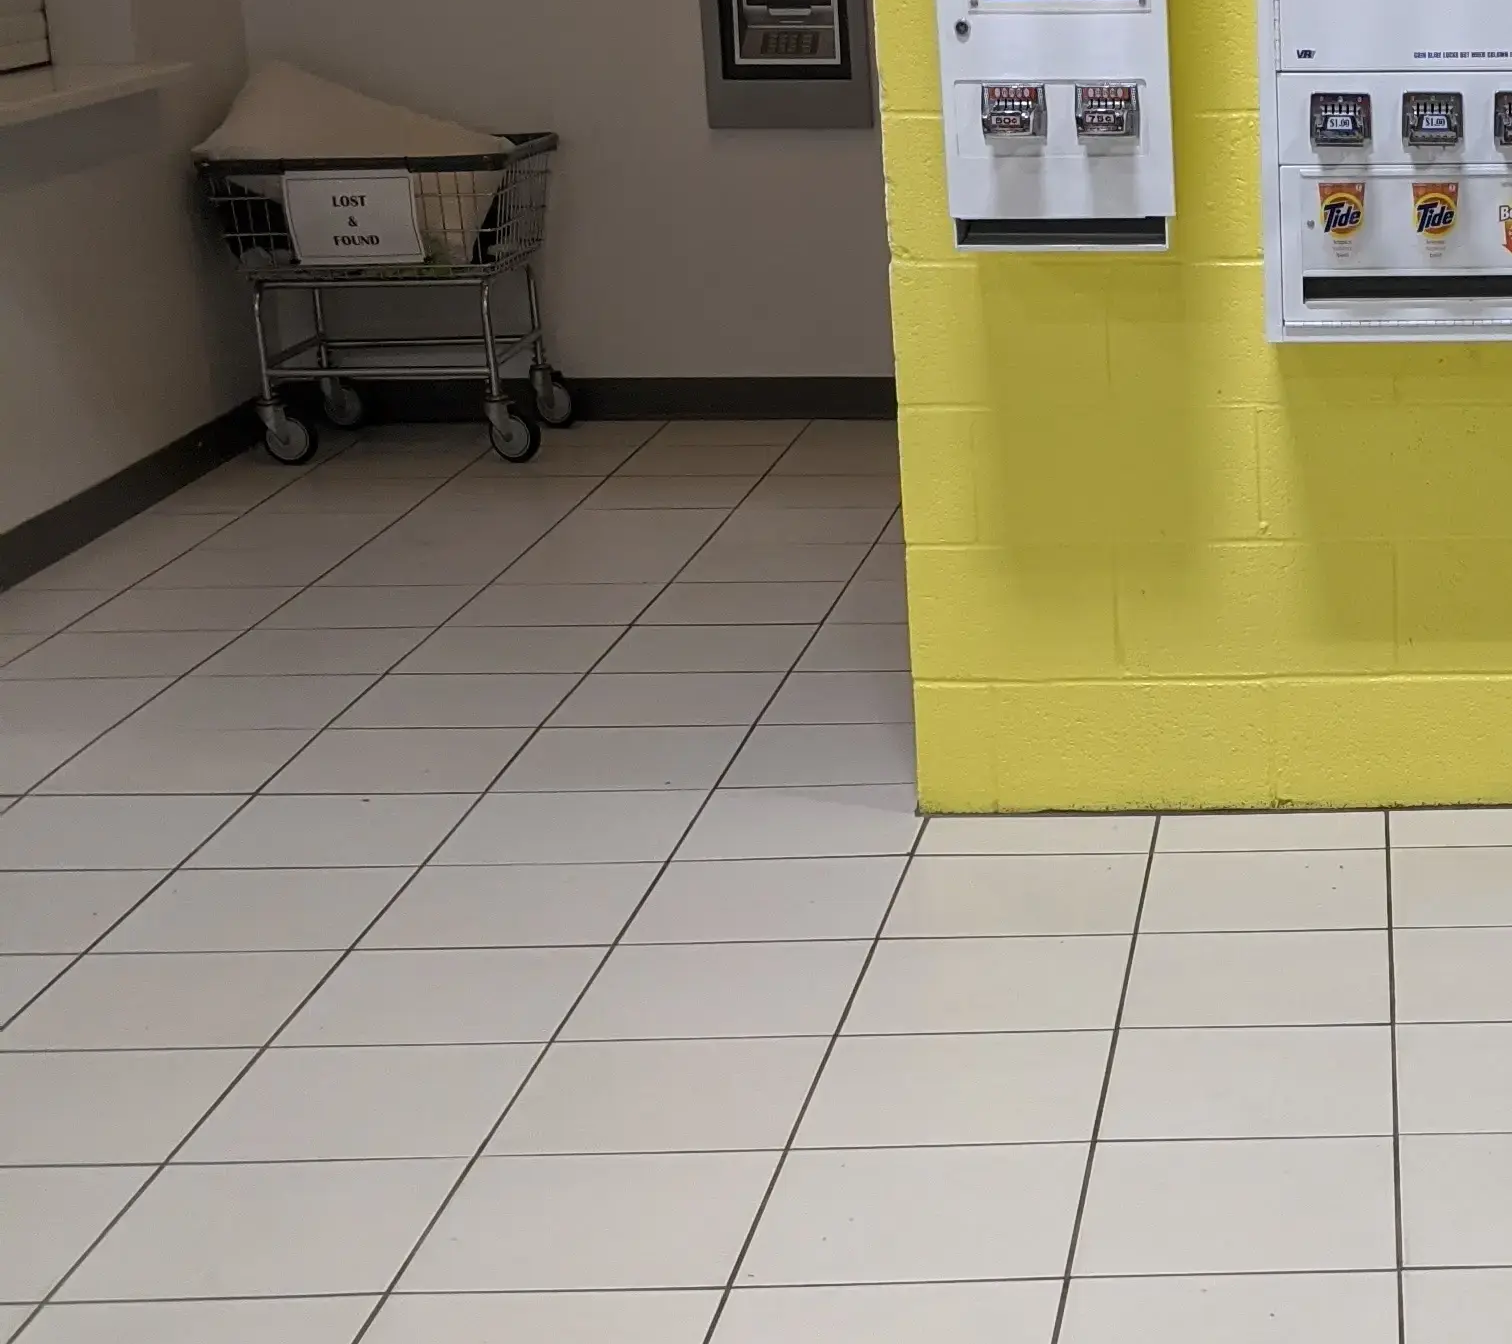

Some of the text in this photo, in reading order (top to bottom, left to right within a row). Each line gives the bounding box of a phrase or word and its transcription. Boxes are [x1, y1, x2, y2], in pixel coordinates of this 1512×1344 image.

[1329, 117, 1349, 128] $1.00
[1425, 117, 1445, 127] $1.00
[332, 195, 366, 207] LOST
[348, 216, 358, 227] &
[1324, 201, 1361, 233] Tide
[1417, 201, 1454, 233] Tide
[333, 235, 380, 246] FOUND
